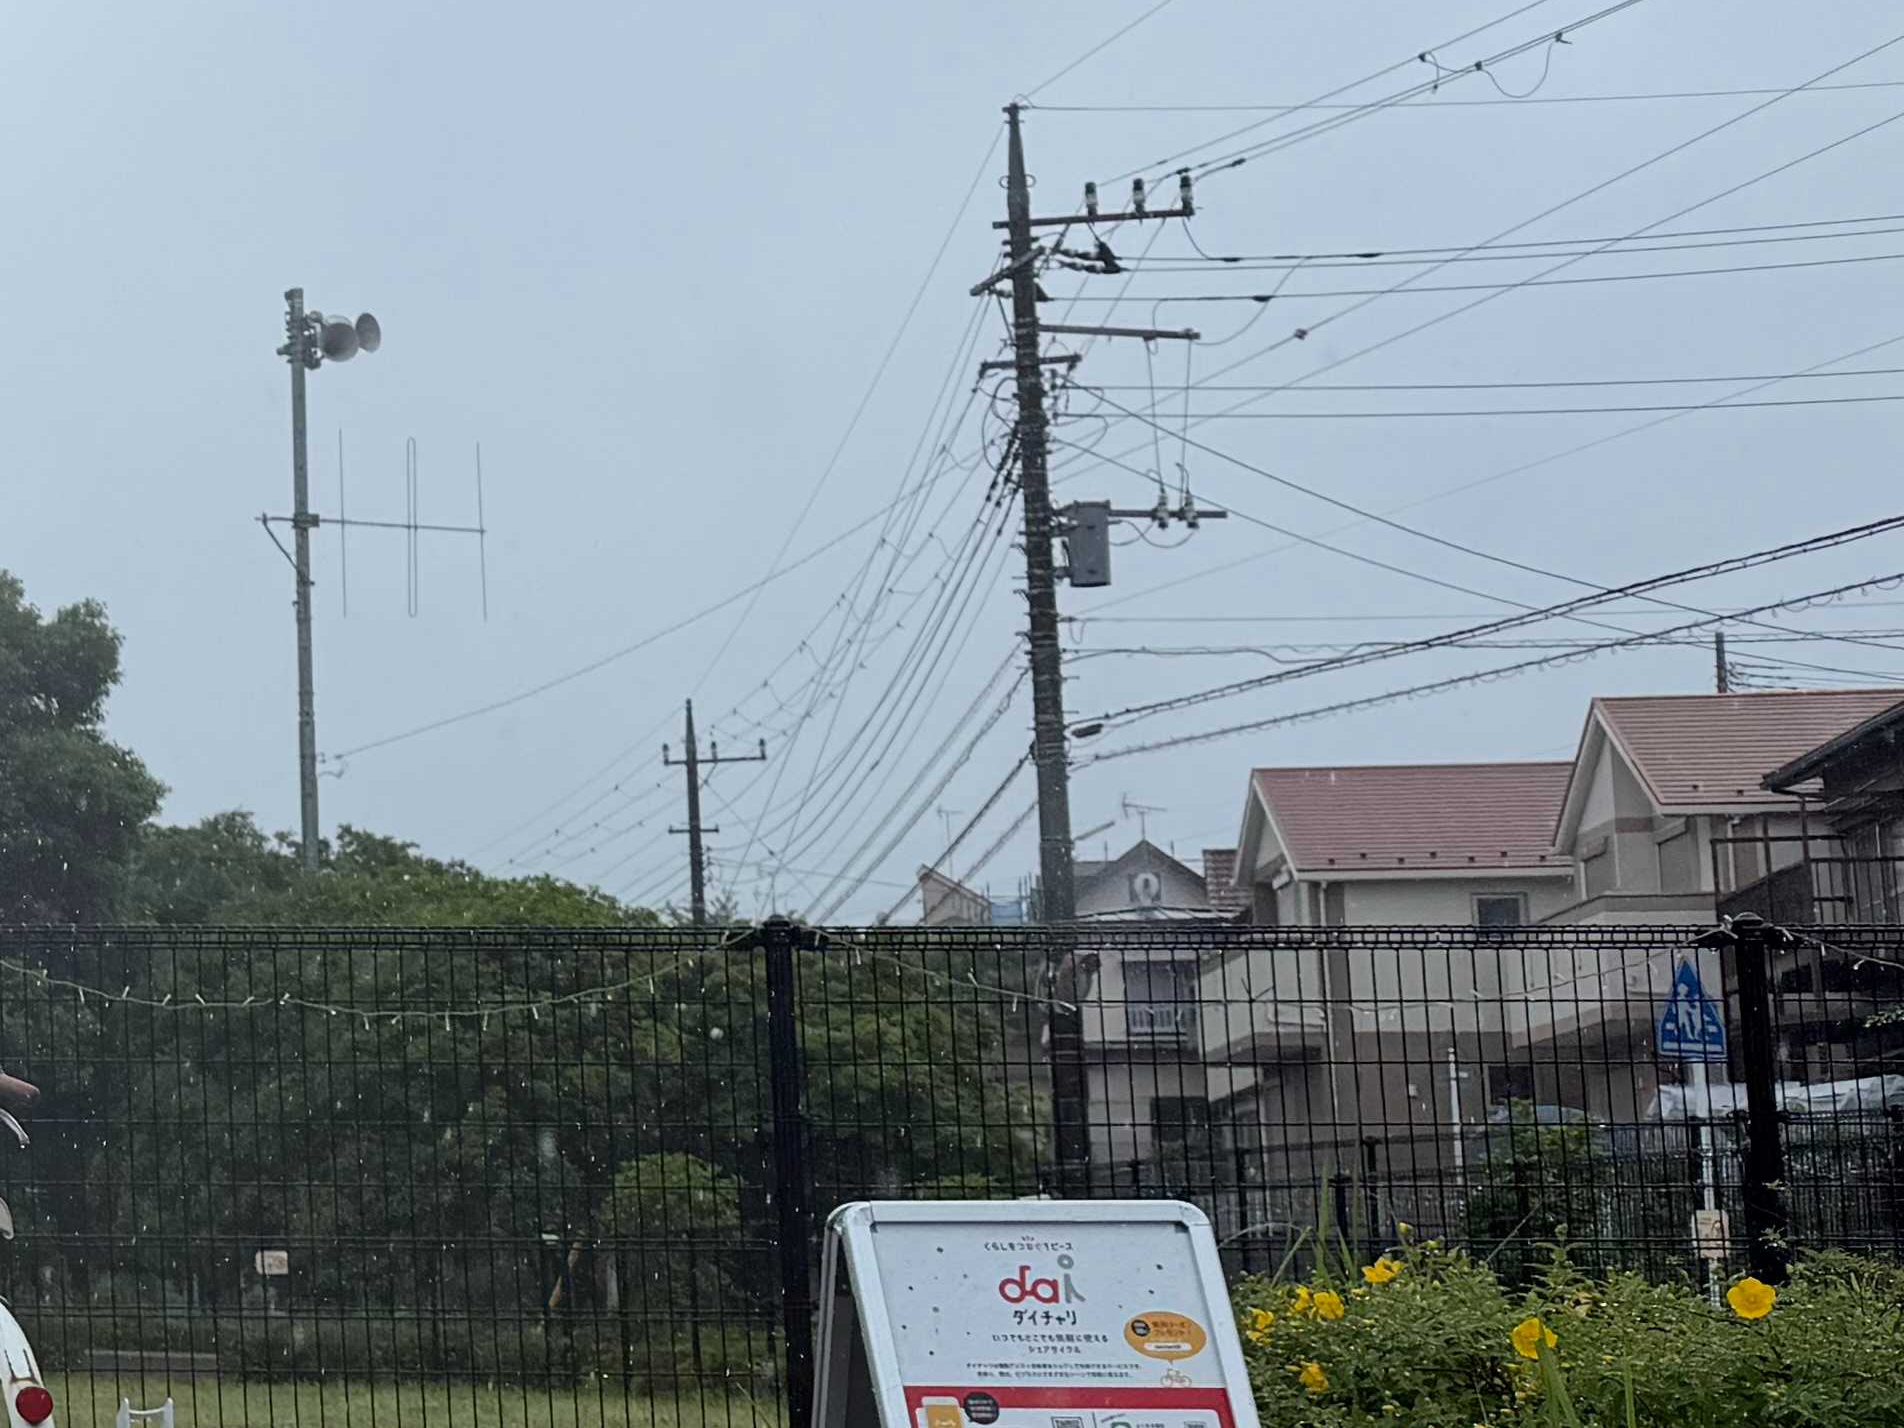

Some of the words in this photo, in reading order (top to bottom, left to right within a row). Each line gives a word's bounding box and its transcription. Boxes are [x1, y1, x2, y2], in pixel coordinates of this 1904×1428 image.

[998, 1254, 1086, 1304] dai
[1012, 1310, 1077, 1326] ダイチャリ
[1028, 1346, 1081, 1354] シェアサイクル
